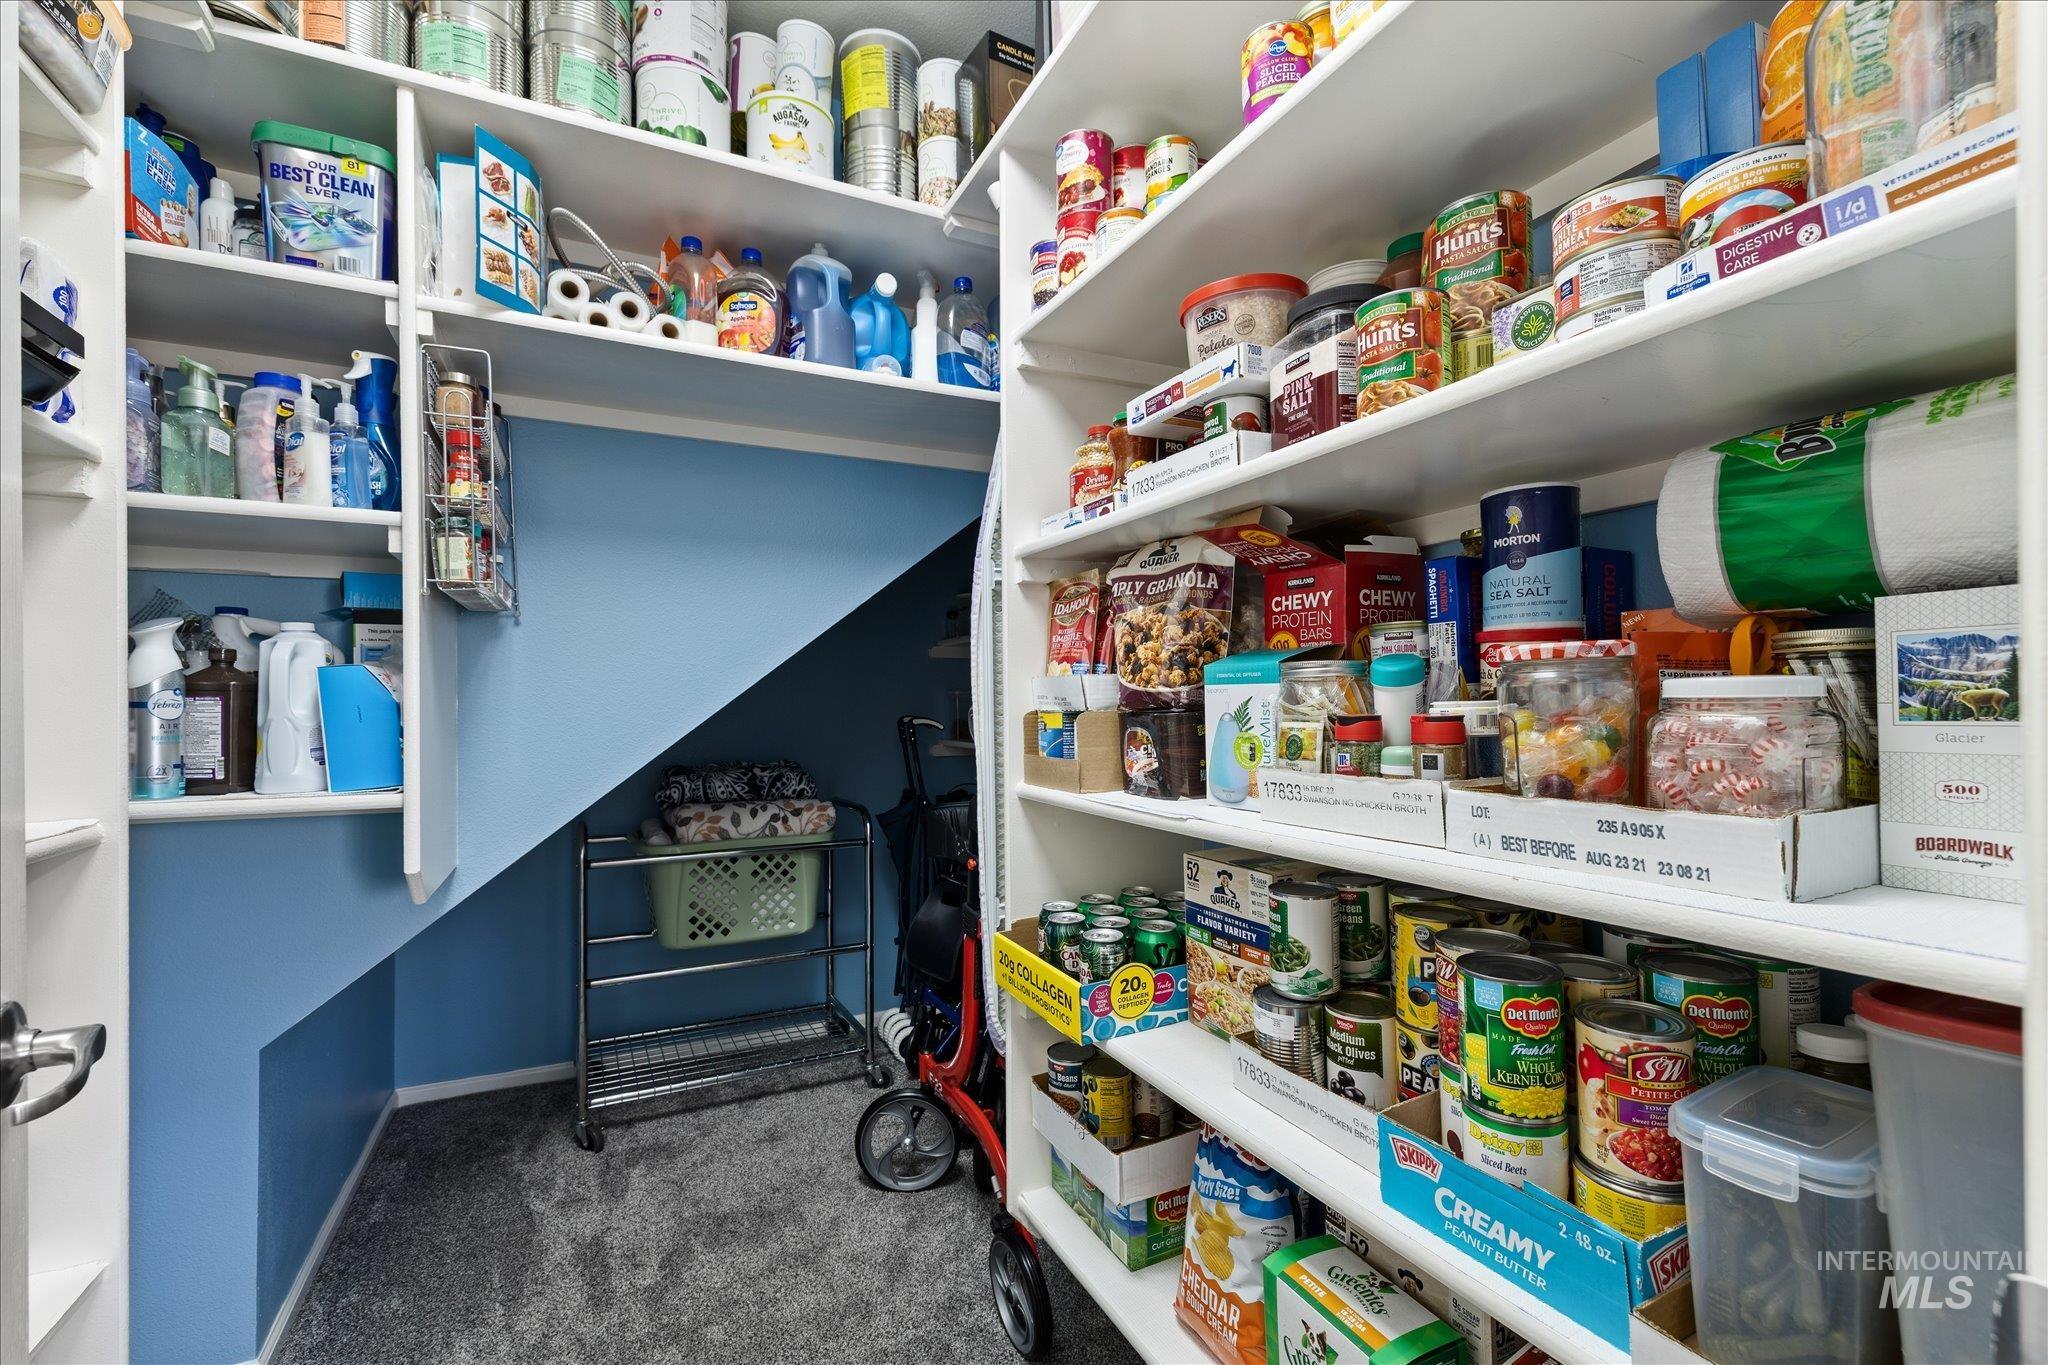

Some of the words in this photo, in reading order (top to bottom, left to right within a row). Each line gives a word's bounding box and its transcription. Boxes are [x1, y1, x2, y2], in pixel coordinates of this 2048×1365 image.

[996, 41, 1022, 57] CANDLE
[1259, 62, 1297, 80] SLICED
[1255, 72, 1302, 91] PEACHES
[650, 106, 683, 116] THRIVE
[652, 114, 672, 123] LIFE
[772, 109, 810, 128] AUGASON
[146, 152, 177, 187] Magic
[307, 160, 338, 174] OUR
[347, 160, 361, 171] 81
[1704, 169, 1730, 184] TENDER
[1730, 161, 1750, 175] CUTS
[1751, 157, 1761, 166] IN
[1761, 152, 1788, 164] GRAVY
[1882, 150, 1961, 188] VETERINARIAN
[145, 165, 176, 197] Eraser
[269, 162, 315, 184] BEST
[318, 172, 375, 199] CLEAN
[1696, 179, 1733, 202] CHICKEN
[1733, 176, 1740, 186] &
[1742, 165, 1780, 181] BROWN
[1780, 161, 1801, 171] RICE
[1727, 175, 1766, 194] ENTRÉE
[1916, 172, 1970, 198] VEGETABLE
[305, 185, 341, 200] EVER
[1445, 207, 1487, 228] PREMIUM
[1571, 204, 1589, 218] BEE
[1838, 217, 1856, 230] low
[1856, 210, 1869, 226] fat
[1435, 218, 1504, 261] Hunt's
[1722, 222, 1795, 262] DIGESTIVE
[1440, 252, 1466, 267] PASTA
[1465, 241, 1497, 260] SAUCE
[1723, 250, 1761, 275] CARE
[1442, 261, 1495, 286] Traditional
[59, 289, 69, 308] 100
[730, 301, 757, 311] Softsoap
[730, 314, 746, 322] Apple
[746, 313, 756, 321] Pie
[1361, 305, 1399, 323] PREMIUM
[1514, 302, 1553, 332] TRADITIONAL
[1593, 306, 1622, 318] Nutrition
[1196, 334, 1237, 356] Potato
[1359, 351, 1379, 365] PASTA
[1378, 340, 1408, 356] SAUCE
[1361, 360, 1407, 384] Traditional
[1283, 372, 1313, 397] PINK
[1282, 386, 1314, 415] SALT
[286, 435, 305, 449] Dial
[1165, 441, 1184, 451] PRO
[1186, 462, 1210, 476] CHICKEN
[1210, 454, 1230, 467] BROTH
[1084, 474, 1109, 486] Orville
[1493, 532, 1541, 549] MORTON
[1139, 551, 1181, 571] QUAKER
[1146, 572, 1219, 596] GRANOLA
[1287, 577, 1315, 587] KIRKLAND
[1376, 573, 1402, 582] KIRKLAND
[1489, 574, 1551, 591] NATURAL
[1271, 589, 1334, 613] CHEWY
[1358, 589, 1418, 607] CHEWY
[1427, 567, 1439, 619] SPAGHETTI
[1489, 589, 1513, 602] SEA
[1516, 585, 1552, 599] SALT
[1053, 595, 1091, 616] IDAHOAN
[1271, 609, 1333, 630] PROTEIN
[1359, 608, 1416, 624] PROTEIN
[1622, 612, 1646, 629] NEW!
[378, 628, 391, 636] pack
[1300, 627, 1333, 641] BARS
[1384, 632, 1413, 640] KIRKLAND
[1449, 622, 1457, 657] Nutrition
[1934, 731, 1986, 746] Glacier
[154, 766, 169, 777] 2X
[1263, 781, 1303, 802] 17833
[1941, 783, 1982, 797] 500
[1302, 794, 1341, 807] SWANSON
[1341, 798, 1354, 808] NG
[1355, 800, 1393, 811] CHICKEN
[1393, 803, 1428, 815] BROTH
[1470, 804, 1491, 820] LOT:
[1596, 819, 1619, 835] 235
[1500, 834, 1529, 854] BEST
[1529, 838, 1577, 862] BEFORE
[1585, 850, 1613, 868] AUG
[1614, 853, 1630, 869] 23
[1632, 856, 1647, 873] 21
[1657, 860, 1674, 878] 23
[1675, 863, 1693, 880] 08
[1695, 866, 1711, 883] 21
[1186, 860, 1200, 882] 52
[1210, 894, 1241, 913] QUAKER
[1197, 915, 1222, 931] FLAVOR
[1223, 924, 1258, 943] VARIETY
[998, 949, 1016, 971] 20g
[1015, 960, 1073, 1012] COLLAGEN
[1008, 975, 1031, 999] BILLION
[1119, 975, 1148, 995] 20g
[1117, 992, 1150, 1004] COLLAGEN
[1507, 1005, 1528, 1021] Del
[1528, 1006, 1559, 1022] Monte
[1687, 1004, 1713, 1018] Del
[1713, 1005, 1750, 1020] Monte
[1524, 1022, 1549, 1033] Quality
[1707, 1020, 1736, 1032] Quality
[1329, 1027, 1366, 1047] Medium
[1344, 1045, 1377, 1061] Olives
[1496, 1069, 1543, 1086] KERNEL
[1543, 1072, 1567, 1086] CORN
[1516, 1060, 1556, 1075] WHOLE
[1635, 1055, 1687, 1083] S&W
[1057, 1073, 1078, 1083] Beans
[1237, 1056, 1272, 1090] 17833
[1271, 1084, 1306, 1108] SWANSON
[1306, 1102, 1319, 1115] NG
[1319, 1109, 1354, 1135] CHICKEN
[1649, 1113, 1668, 1121] Diced
[1467, 1121, 1526, 1156] Daizy
[1400, 1145, 1440, 1179] SKIPPY
[1480, 1153, 1504, 1169] Sliced
[1504, 1160, 1528, 1177] Beets
[1197, 1175, 1215, 1197] Party
[1215, 1179, 1241, 1202] Size!
[1433, 1186, 1557, 1272] CREAMY
[1443, 1220, 1497, 1258] PEANUT
[1495, 1250, 1549, 1291] BUTTER
[1596, 1247, 1618, 1265] oz.
[1182, 1262, 1241, 1331] CHEDDAR
[1298, 1274, 1329, 1299] PETITE
[1327, 1264, 1389, 1316] Greenies
[1186, 1288, 1206, 1316] SOUR
[1205, 1310, 1239, 1344] CREAM
